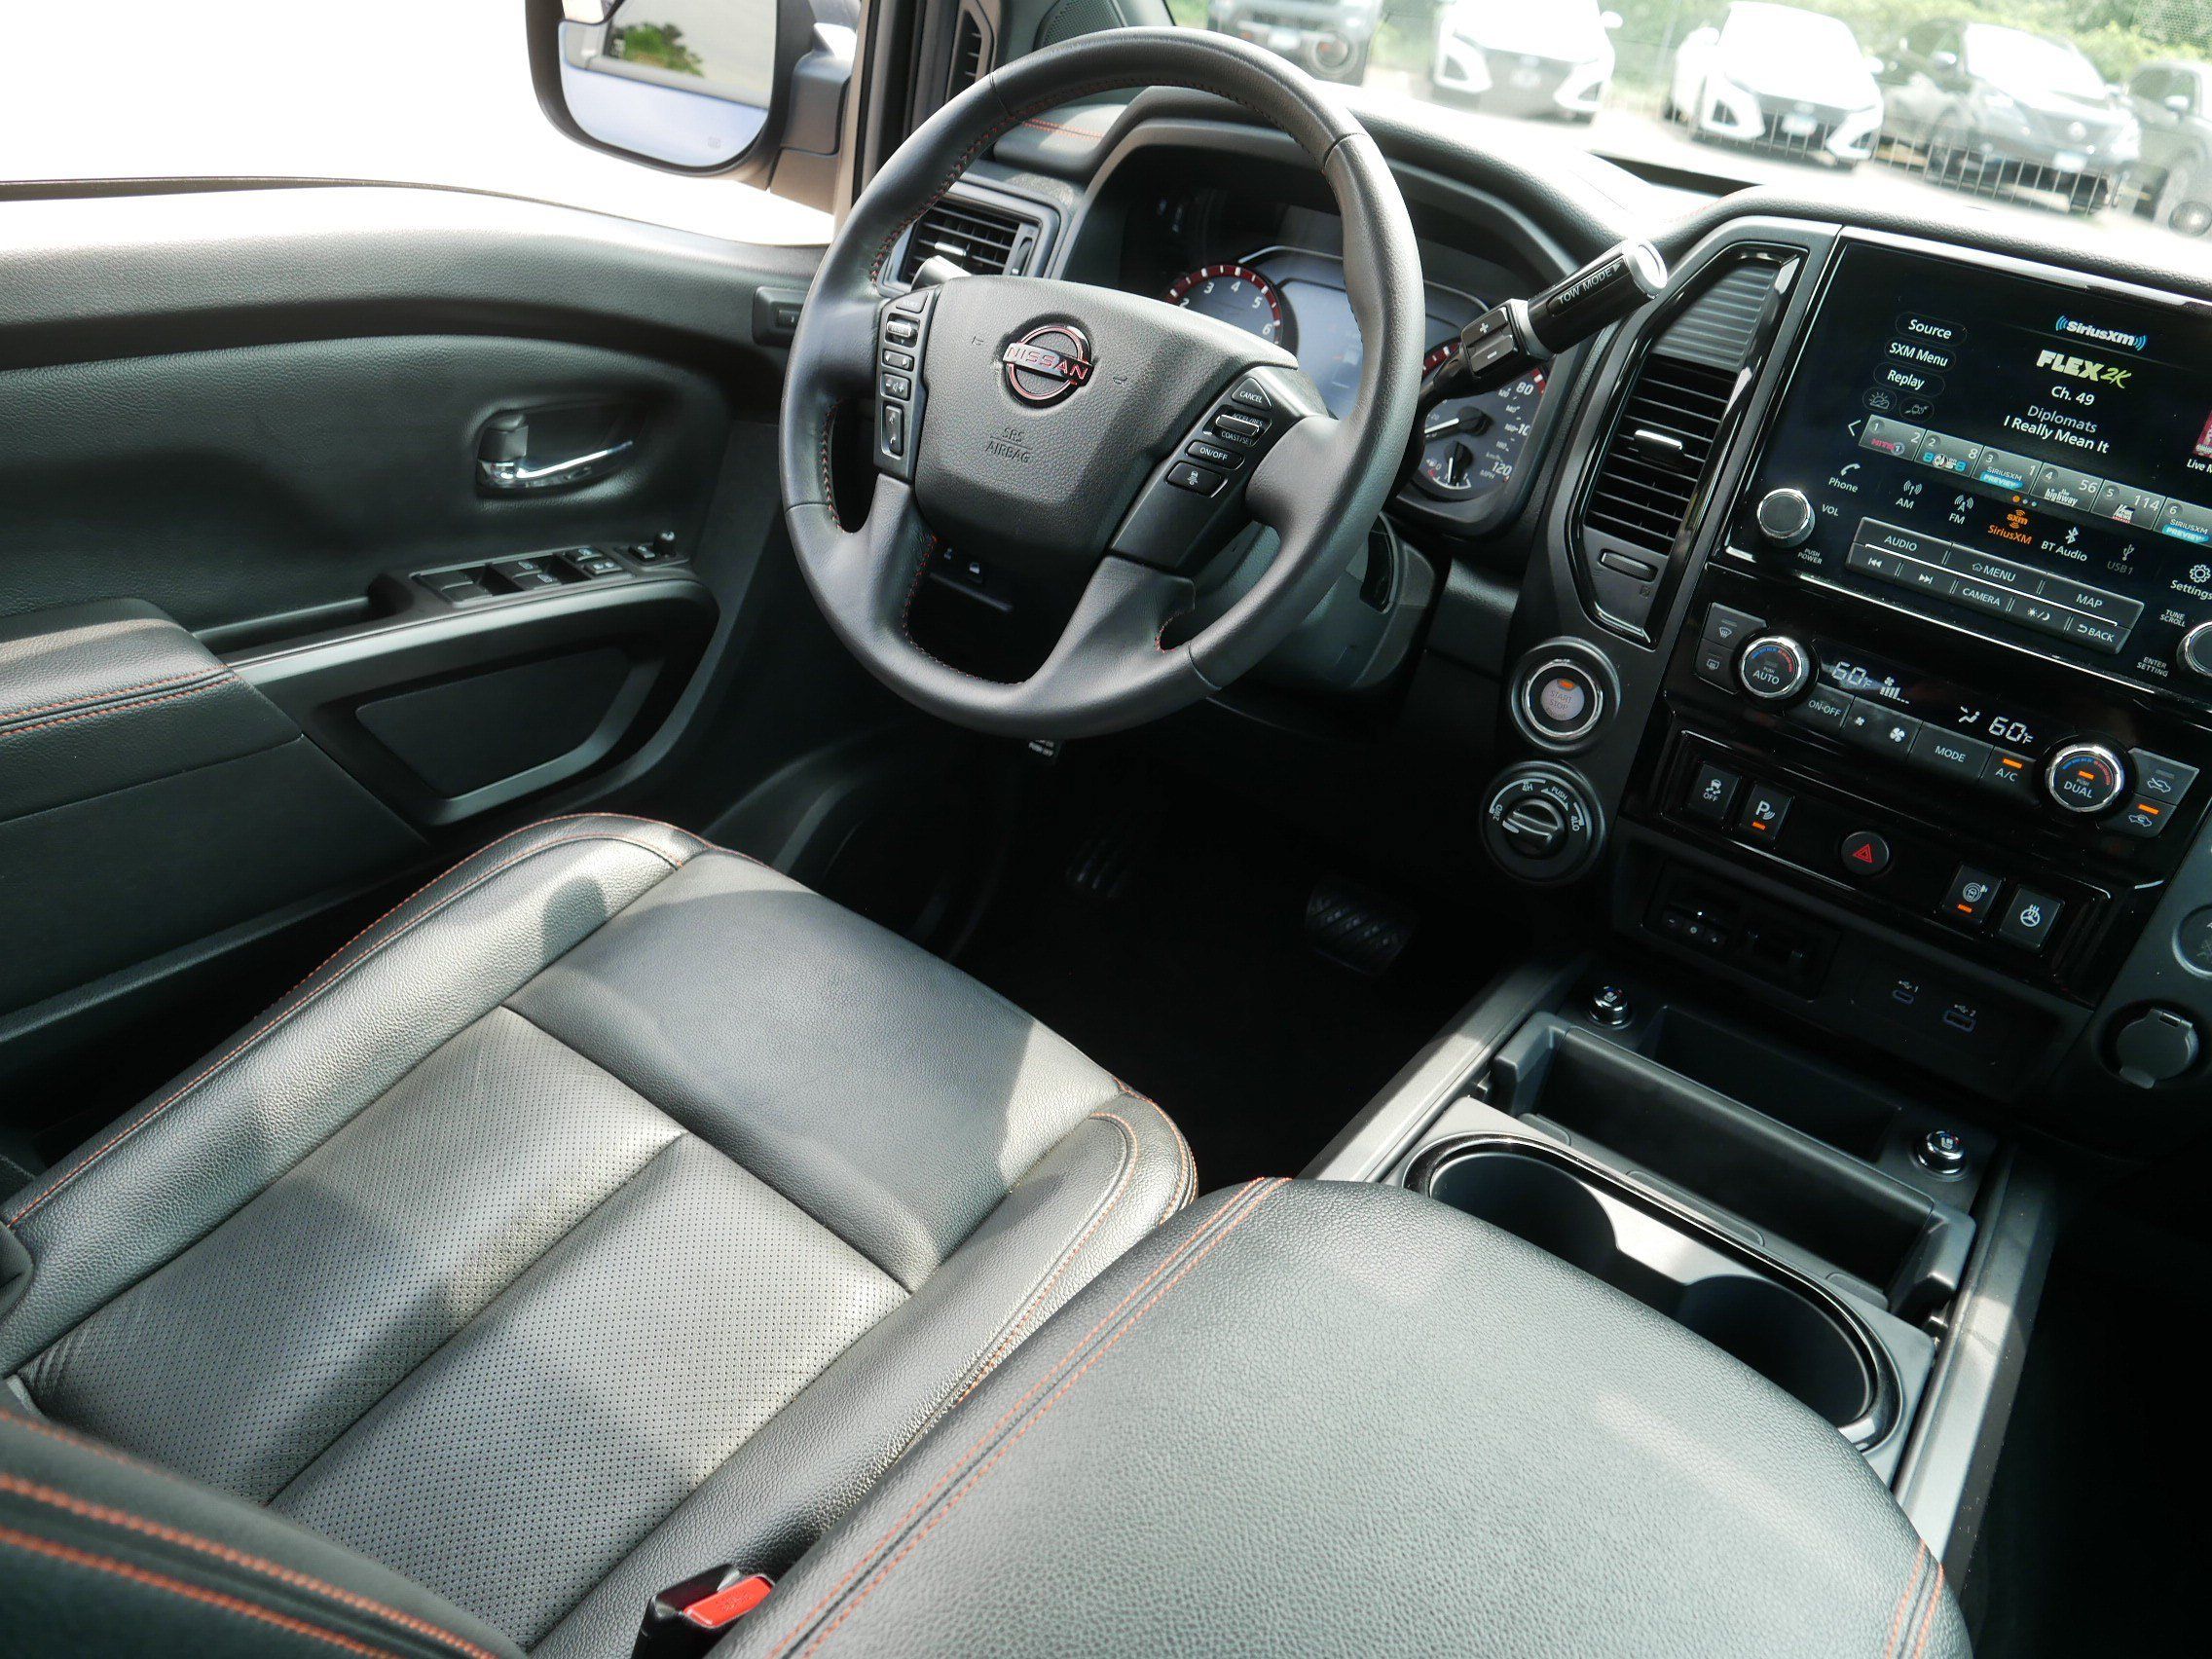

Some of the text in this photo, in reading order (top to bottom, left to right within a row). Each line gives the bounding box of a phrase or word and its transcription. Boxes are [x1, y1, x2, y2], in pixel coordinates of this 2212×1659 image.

[1203, 282, 1214, 294] 3
[1231, 281, 1240, 292] 4
[1558, 268, 1613, 304] TOW MODE
[1252, 297, 1263, 309] 5
[1262, 323, 1273, 335] 6
[1908, 319, 1952, 339] Source
[1889, 343, 1948, 367] SXM Menu
[1006, 347, 1088, 380] NISSAN
[1887, 370, 1925, 390] Replay
[1516, 382, 1534, 395] 80
[1239, 390, 1263, 403] CANCEL
[2051, 387, 2095, 406] Ch. 49
[2027, 405, 2097, 433] Diplomats
[1873, 423, 1879, 431] 1
[2004, 415, 2110, 454] I Really Mean It
[1002, 427, 1023, 443] SRS
[1221, 430, 1253, 445] COAST/SET
[1910, 431, 1921, 444] 2
[1929, 438, 1936, 447] 2
[985, 440, 1030, 463] AIRBAG
[1199, 447, 1228, 461] ON/OFF
[1968, 448, 1978, 460] 8
[1986, 455, 1994, 463] 3
[1492, 461, 1513, 476] 120
[2029, 465, 2036, 476] 1
[2187, 459, 2205, 471] Live
[1983, 473, 2017, 488] PREVIEW
[1986, 466, 2022, 481] SIRIUSXM
[2045, 471, 2053, 480] 4
[1828, 477, 1859, 494] Phone
[2079, 479, 2098, 494] 56
[1896, 498, 1914, 509] AM
[2045, 488, 2079, 507] highway
[2134, 495, 2160, 511] 114
[1822, 504, 1839, 517] VOL
[2169, 505, 2178, 516] 6
[1948, 512, 1966, 525] FM
[2166, 526, 2206, 542] PREVIEW
[2169, 519, 2208, 535] SIRIUSXM
[1988, 525, 2033, 545] SiriusXM
[1884, 535, 1918, 552] AUDIO
[2041, 540, 2087, 562] BT Audio
[1797, 552, 1823, 565] POWER
[1983, 565, 2016, 582] MENU
[1962, 587, 2001, 607] CAMERA
[2170, 579, 2212, 601] Settings
[2076, 593, 2103, 608] MAP
[2159, 614, 2186, 627] SCROLL
[2165, 609, 2186, 620] TUNE
[2087, 627, 2116, 643] BACK
[2136, 662, 2169, 678] SETTING
[2143, 657, 2167, 670] ENTER
[1752, 670, 1780, 685] AUTO
[1936, 745, 1967, 762] MODE
[1996, 767, 2017, 782] A/C
[1551, 786, 1568, 801] PUSH
[1703, 792, 1717, 801] OFF
[2064, 781, 2092, 798] DUAL
